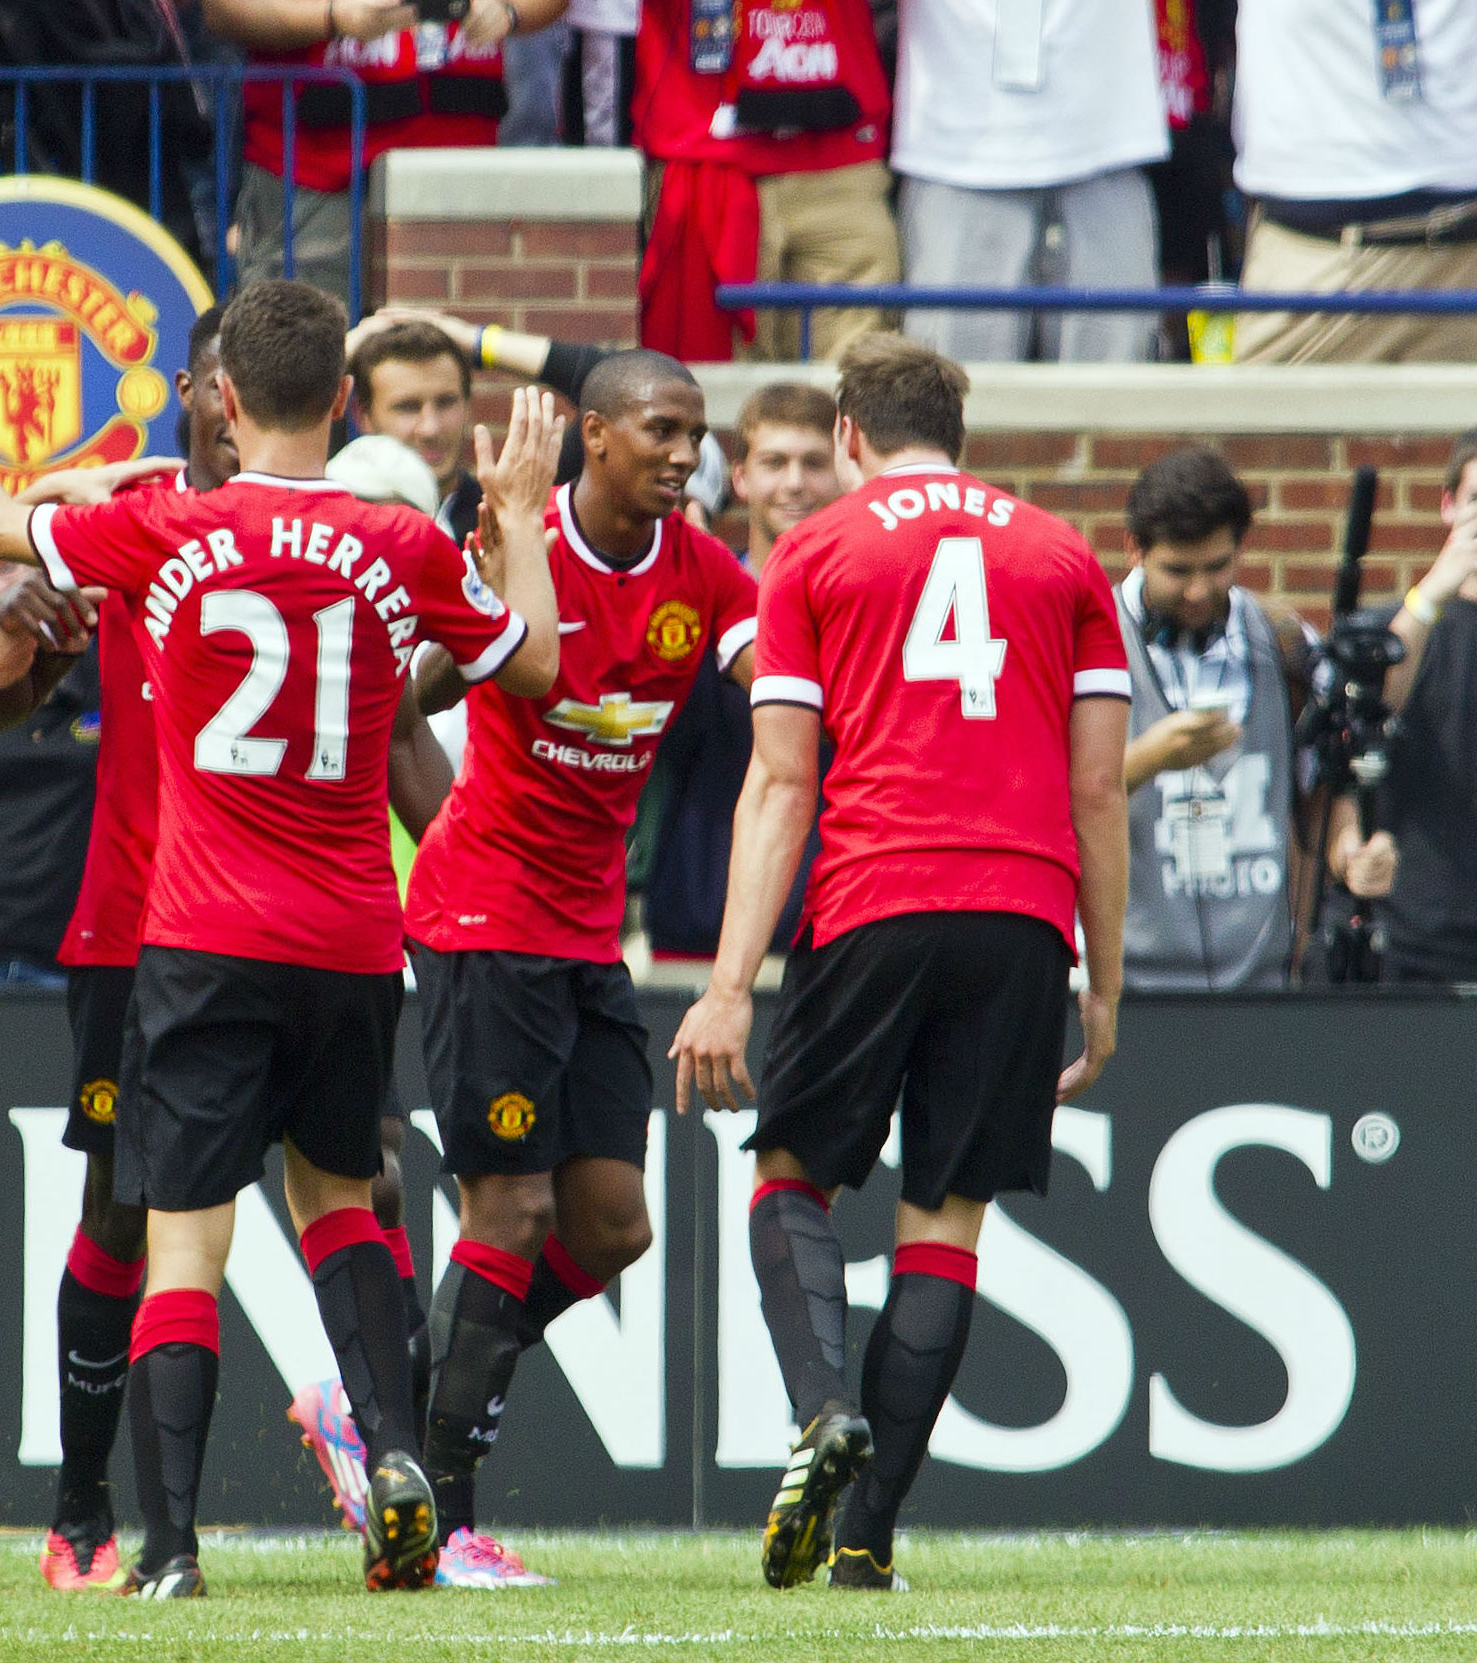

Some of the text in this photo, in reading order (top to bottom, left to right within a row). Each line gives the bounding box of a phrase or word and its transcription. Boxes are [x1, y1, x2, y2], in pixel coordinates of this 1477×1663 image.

[868, 482, 1015, 531] JONES
[144, 517, 418, 678] ANDER HERRERA
[902, 537, 1008, 720] 4
[194, 588, 355, 782] 21
